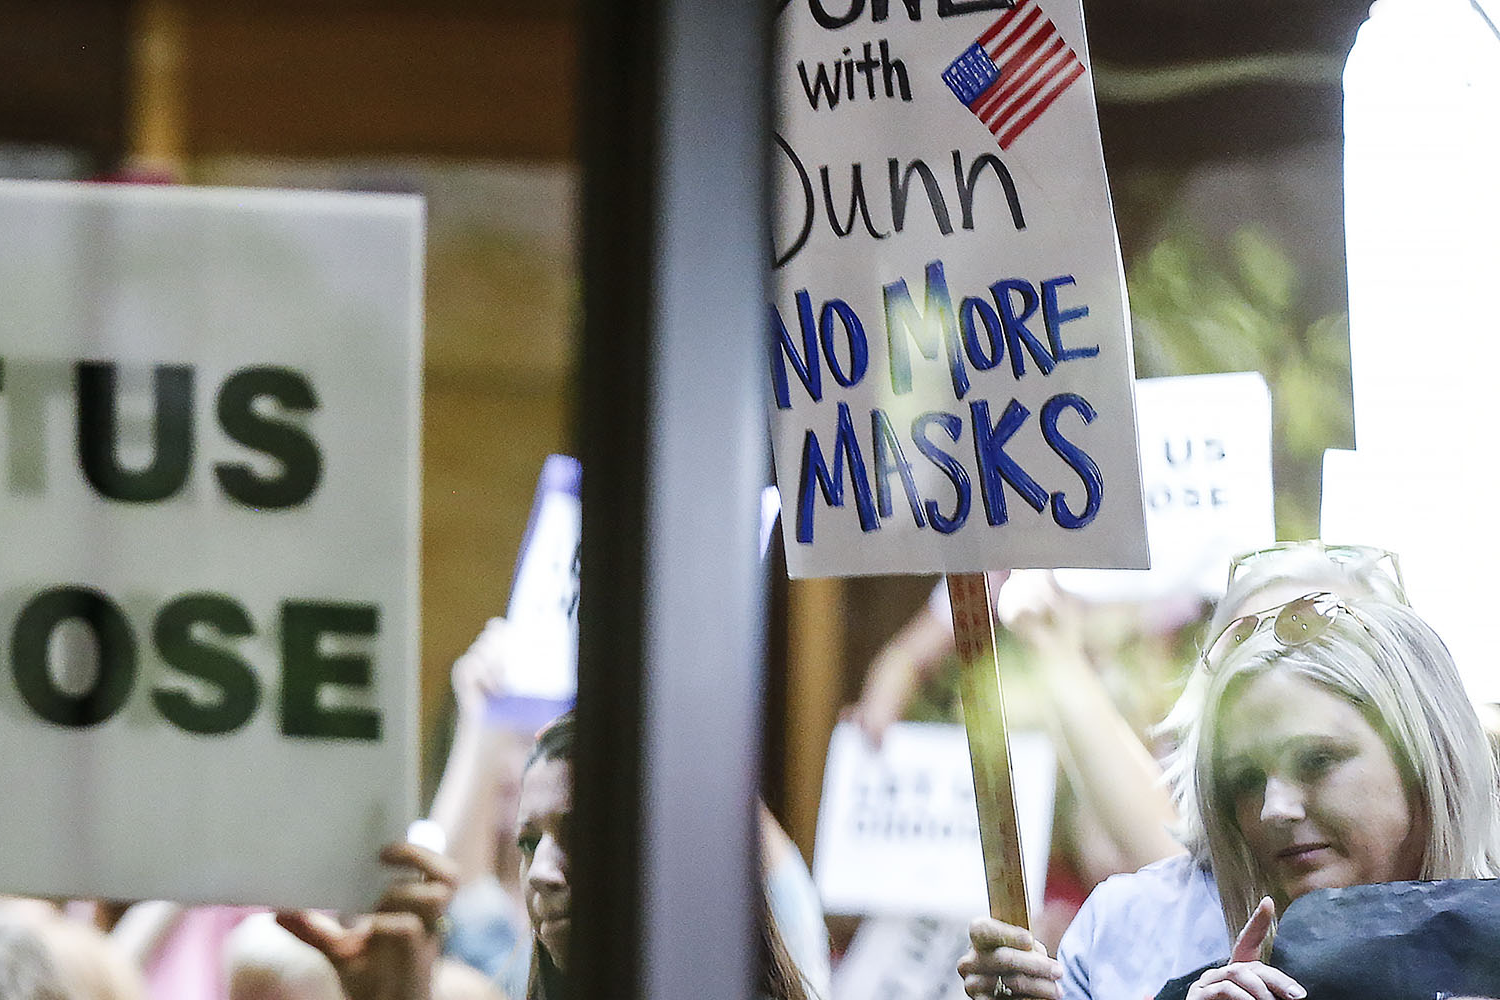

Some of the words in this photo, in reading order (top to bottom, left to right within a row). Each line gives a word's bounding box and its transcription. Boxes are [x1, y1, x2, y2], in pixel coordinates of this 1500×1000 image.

[796, 38, 913, 111] with
[771, 287, 869, 410] NO
[883, 259, 1100, 400] MORE
[76, 360, 325, 511] US
[795, 392, 1104, 545] MASKS
